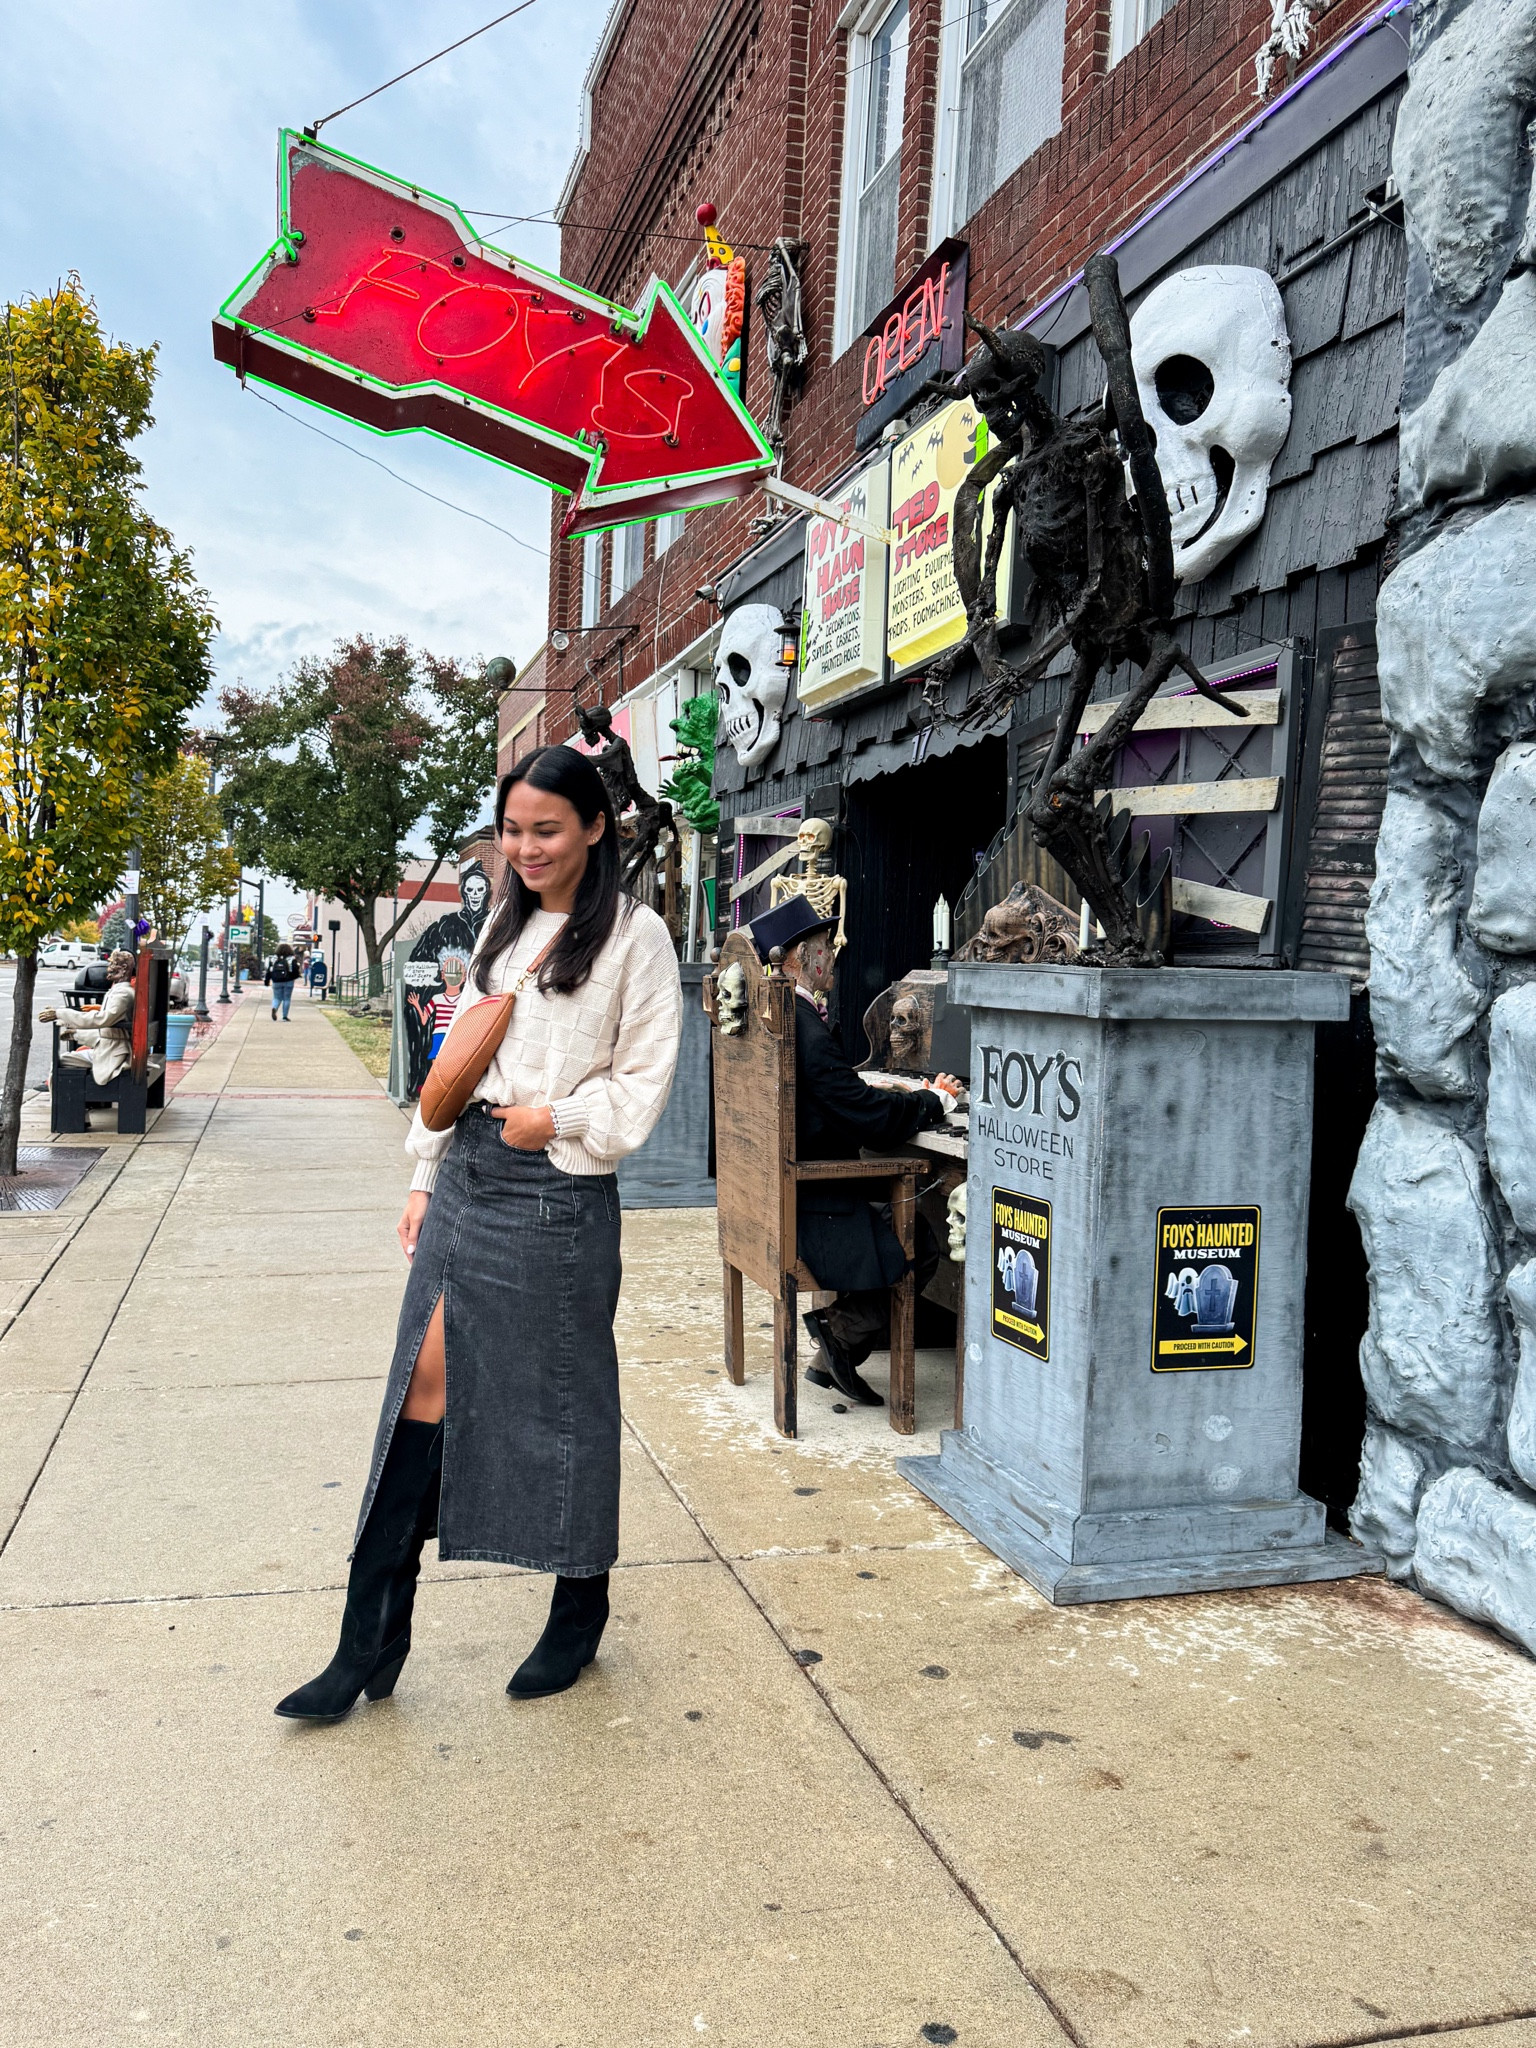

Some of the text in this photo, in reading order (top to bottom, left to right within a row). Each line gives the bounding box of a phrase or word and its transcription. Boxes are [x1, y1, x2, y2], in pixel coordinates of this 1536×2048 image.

[862, 262, 949, 405] OPEN
[892, 480, 940, 541] TED
[809, 498, 852, 572] FOYS
[894, 511, 949, 576] STORE
[816, 535, 865, 598] HAUN
[893, 548, 954, 599] LIGHTING EQUIPME
[821, 574, 861, 624] HOUSE
[891, 586, 927, 619] MONSTERS,
[821, 643, 861, 675] HAUNTED HOUSE
[231, 928, 240, 940] P
[976, 1045, 1083, 1123] FOY'S
[978, 1115, 1074, 1159] HALLOWEEN
[994, 1148, 1054, 1180] STORE
[995, 1202, 1048, 1239] FOYS HAUNTED
[1001, 1227, 1040, 1249] MUSEUM
[1162, 1223, 1254, 1248] FOYS HAUNTED
[1173, 1248, 1241, 1260] MUSEUM
[1173, 1341, 1235, 1351] PROCEED WITH CAUTION
